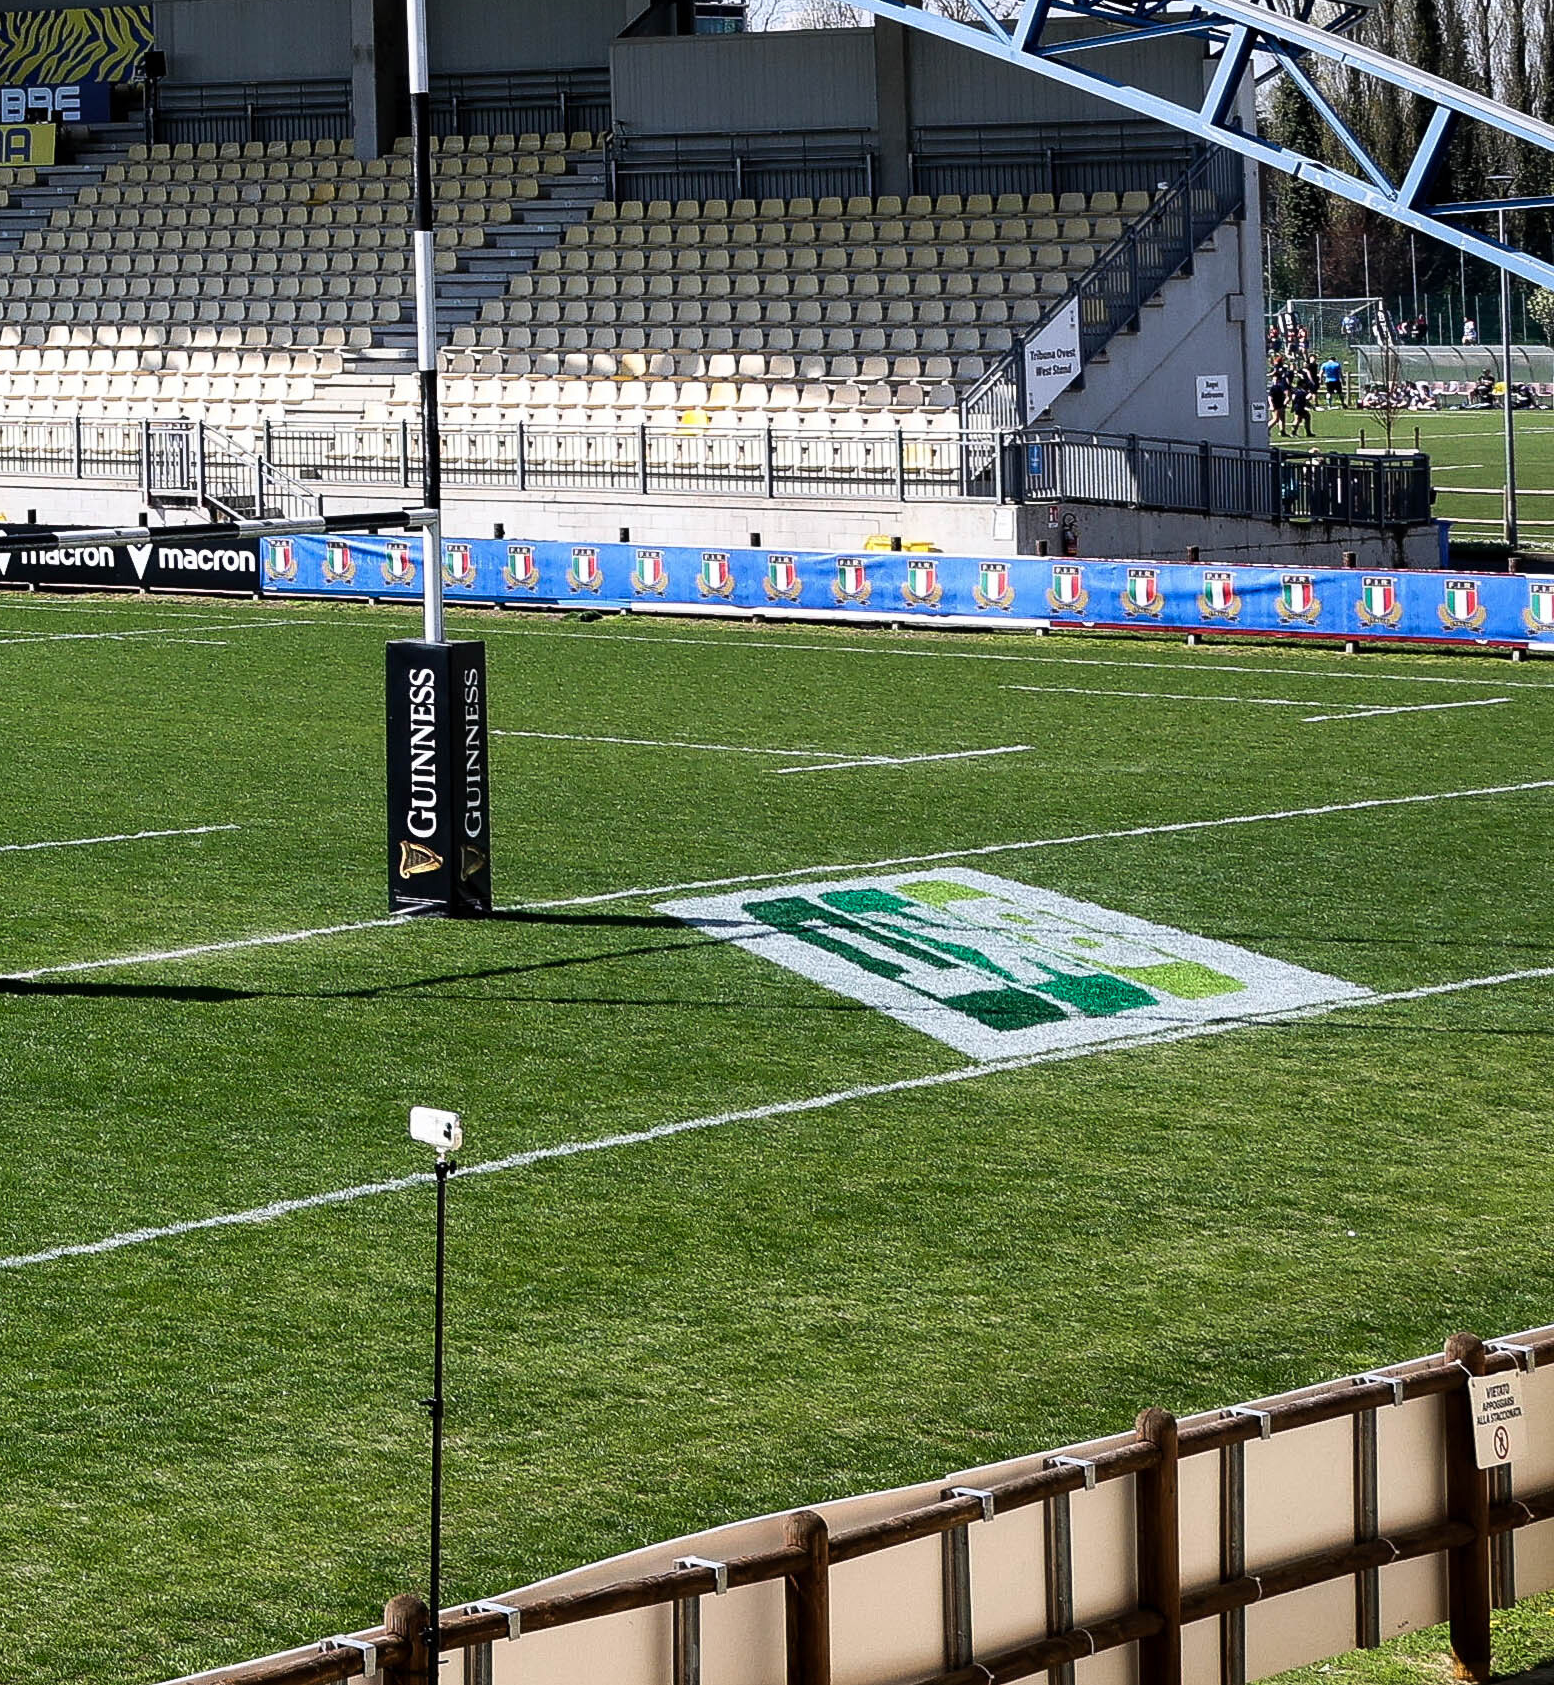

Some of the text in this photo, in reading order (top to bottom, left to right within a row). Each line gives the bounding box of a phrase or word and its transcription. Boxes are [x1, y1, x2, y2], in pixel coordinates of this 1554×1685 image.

[159, 547, 256, 572] macron
[406, 667, 437, 839] GUINNESS
[464, 667, 481, 839] GUINNESS
[1486, 1383, 1510, 1398] VIETATO
